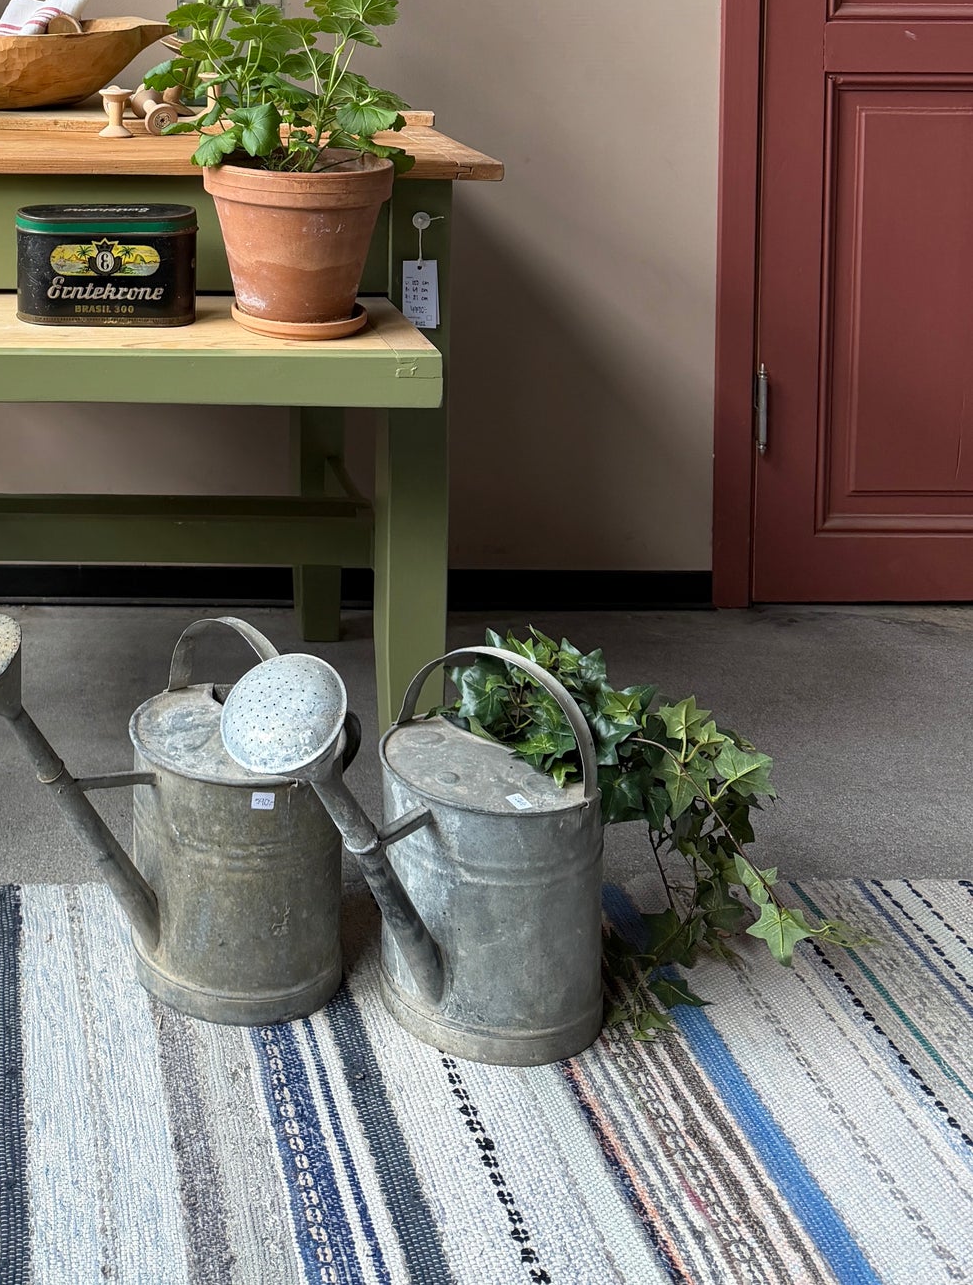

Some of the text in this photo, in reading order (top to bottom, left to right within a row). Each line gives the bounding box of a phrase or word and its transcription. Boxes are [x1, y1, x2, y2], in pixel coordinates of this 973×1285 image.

[47, 276, 164, 301] Erntekrone
[74, 304, 135, 314] BRASIL 300
